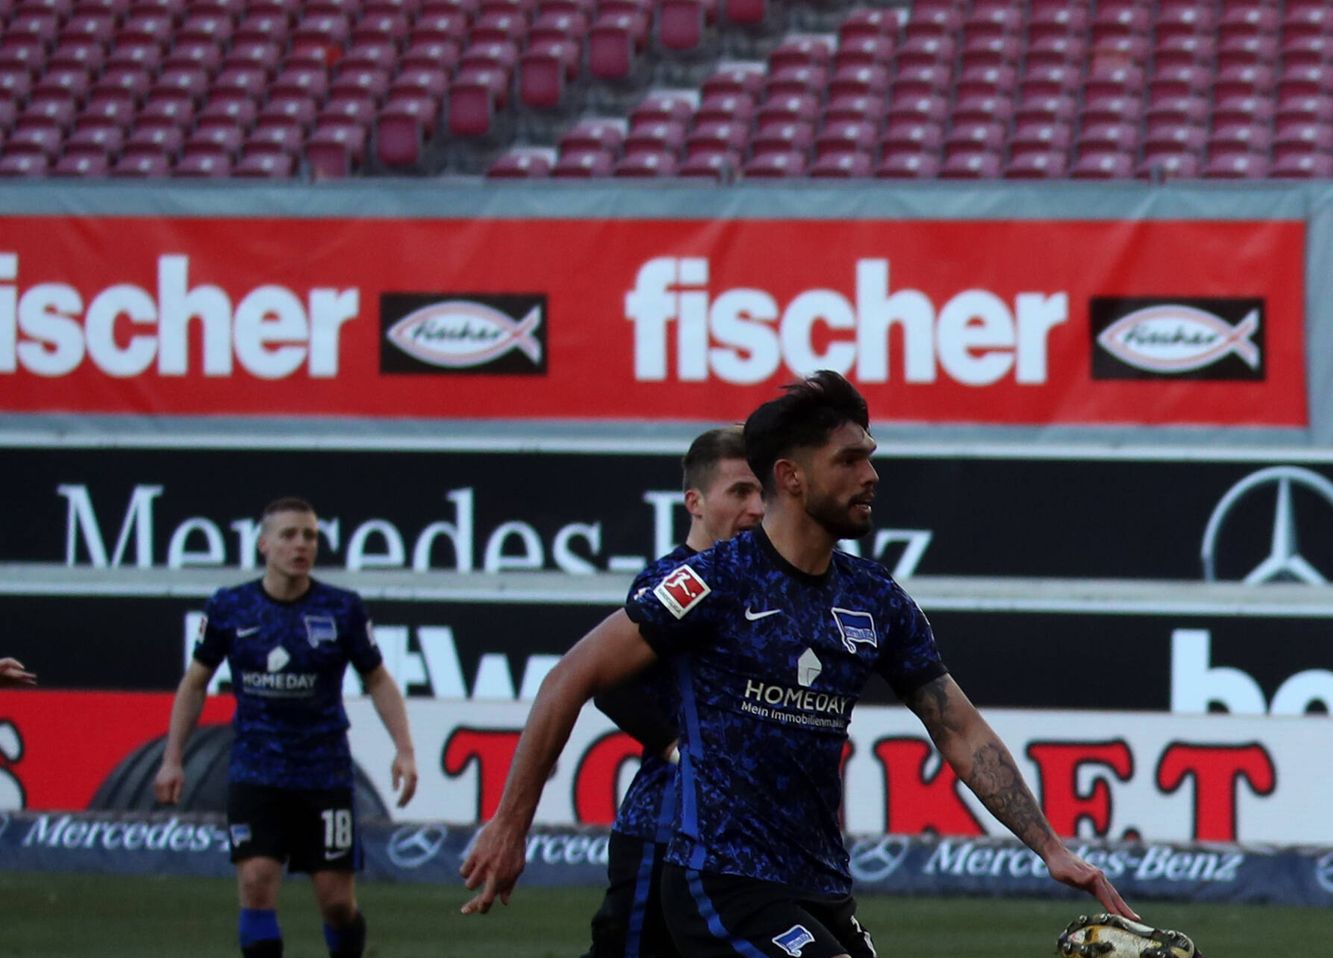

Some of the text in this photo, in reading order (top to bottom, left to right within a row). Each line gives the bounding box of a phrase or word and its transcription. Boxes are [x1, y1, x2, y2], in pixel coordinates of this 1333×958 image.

[626, 256, 1070, 387] fischer
[242, 671, 317, 689] HOMEDAY
[744, 679, 849, 715] HOMEDAY
[741, 700, 769, 717] Mein
[321, 809, 351, 849] 18
